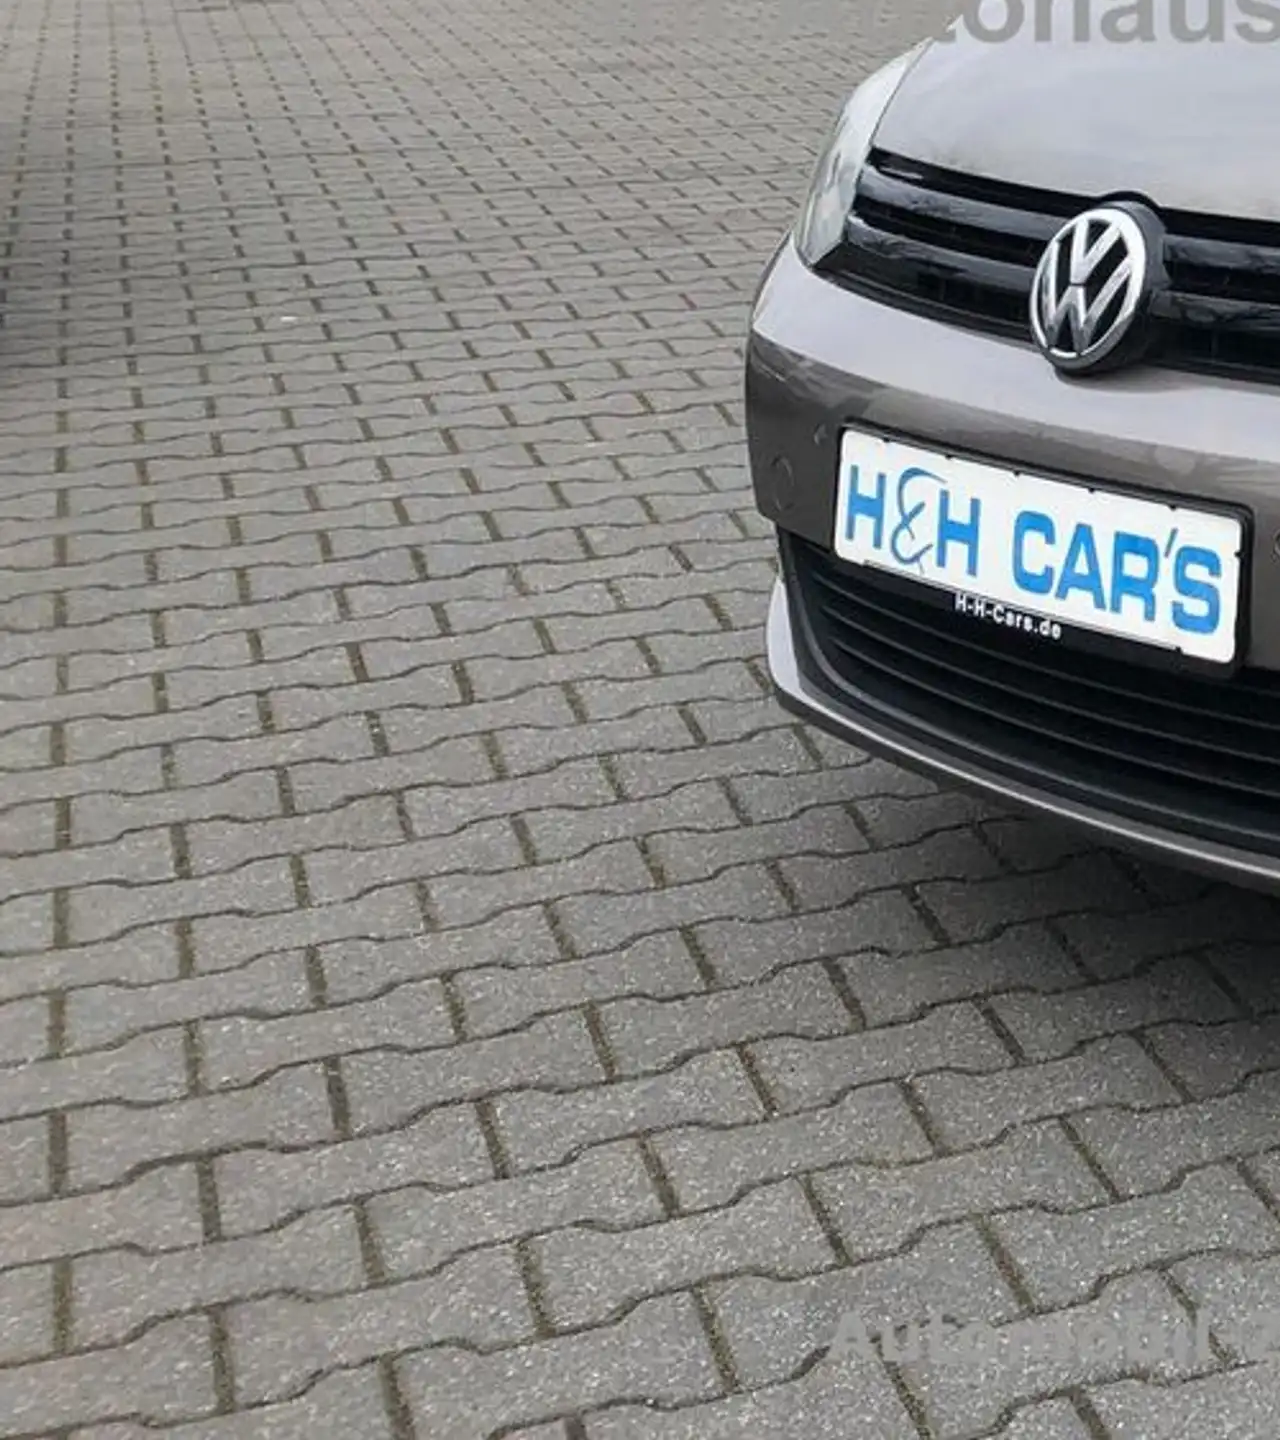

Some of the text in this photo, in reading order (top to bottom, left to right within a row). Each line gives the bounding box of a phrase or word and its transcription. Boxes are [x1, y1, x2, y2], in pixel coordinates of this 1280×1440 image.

[845, 463, 1222, 635] H&H CAR'S
[954, 590, 1062, 641] H-H-Cars.de
